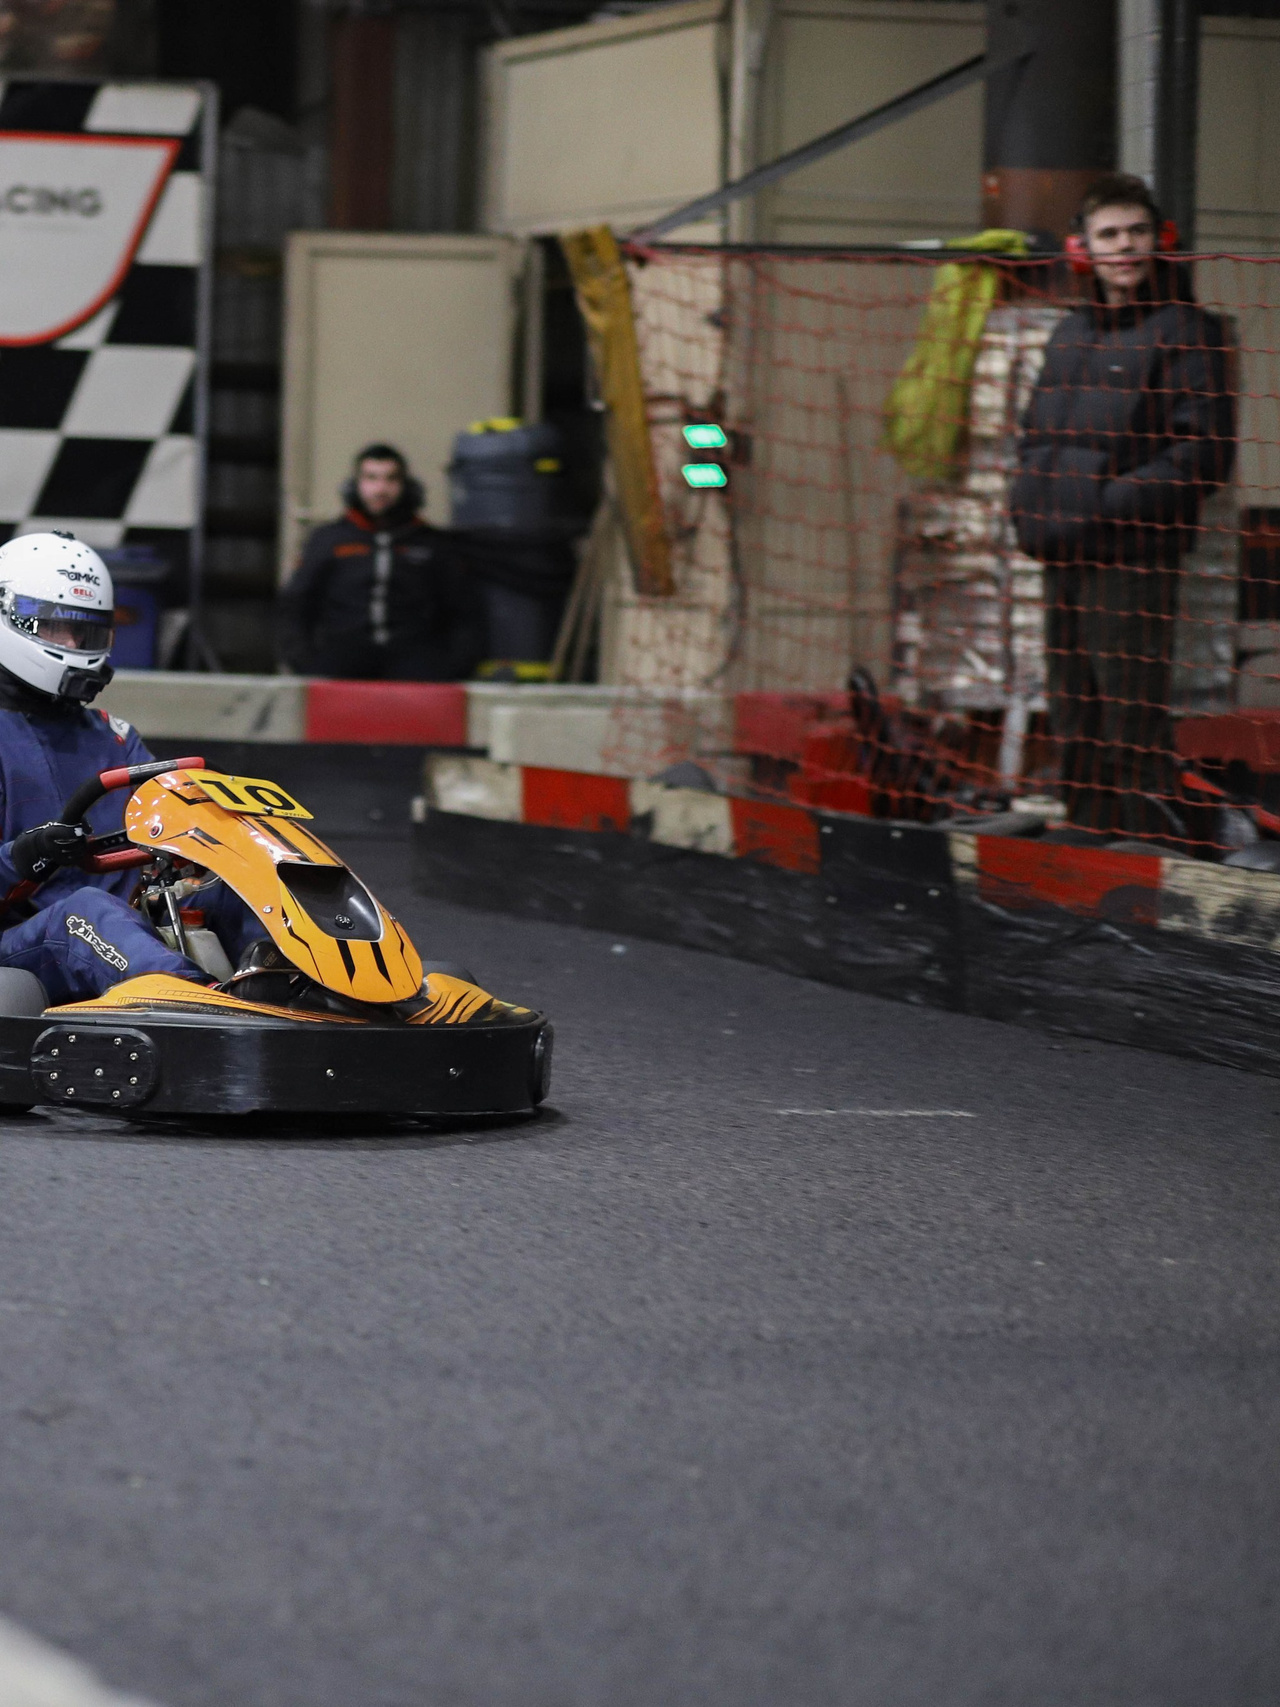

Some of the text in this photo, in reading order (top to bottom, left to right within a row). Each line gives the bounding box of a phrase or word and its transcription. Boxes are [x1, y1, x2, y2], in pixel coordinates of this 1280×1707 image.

[73, 588, 94, 598] BELL
[198, 779, 296, 811] 10
[66, 915, 128, 971] alpinestars
